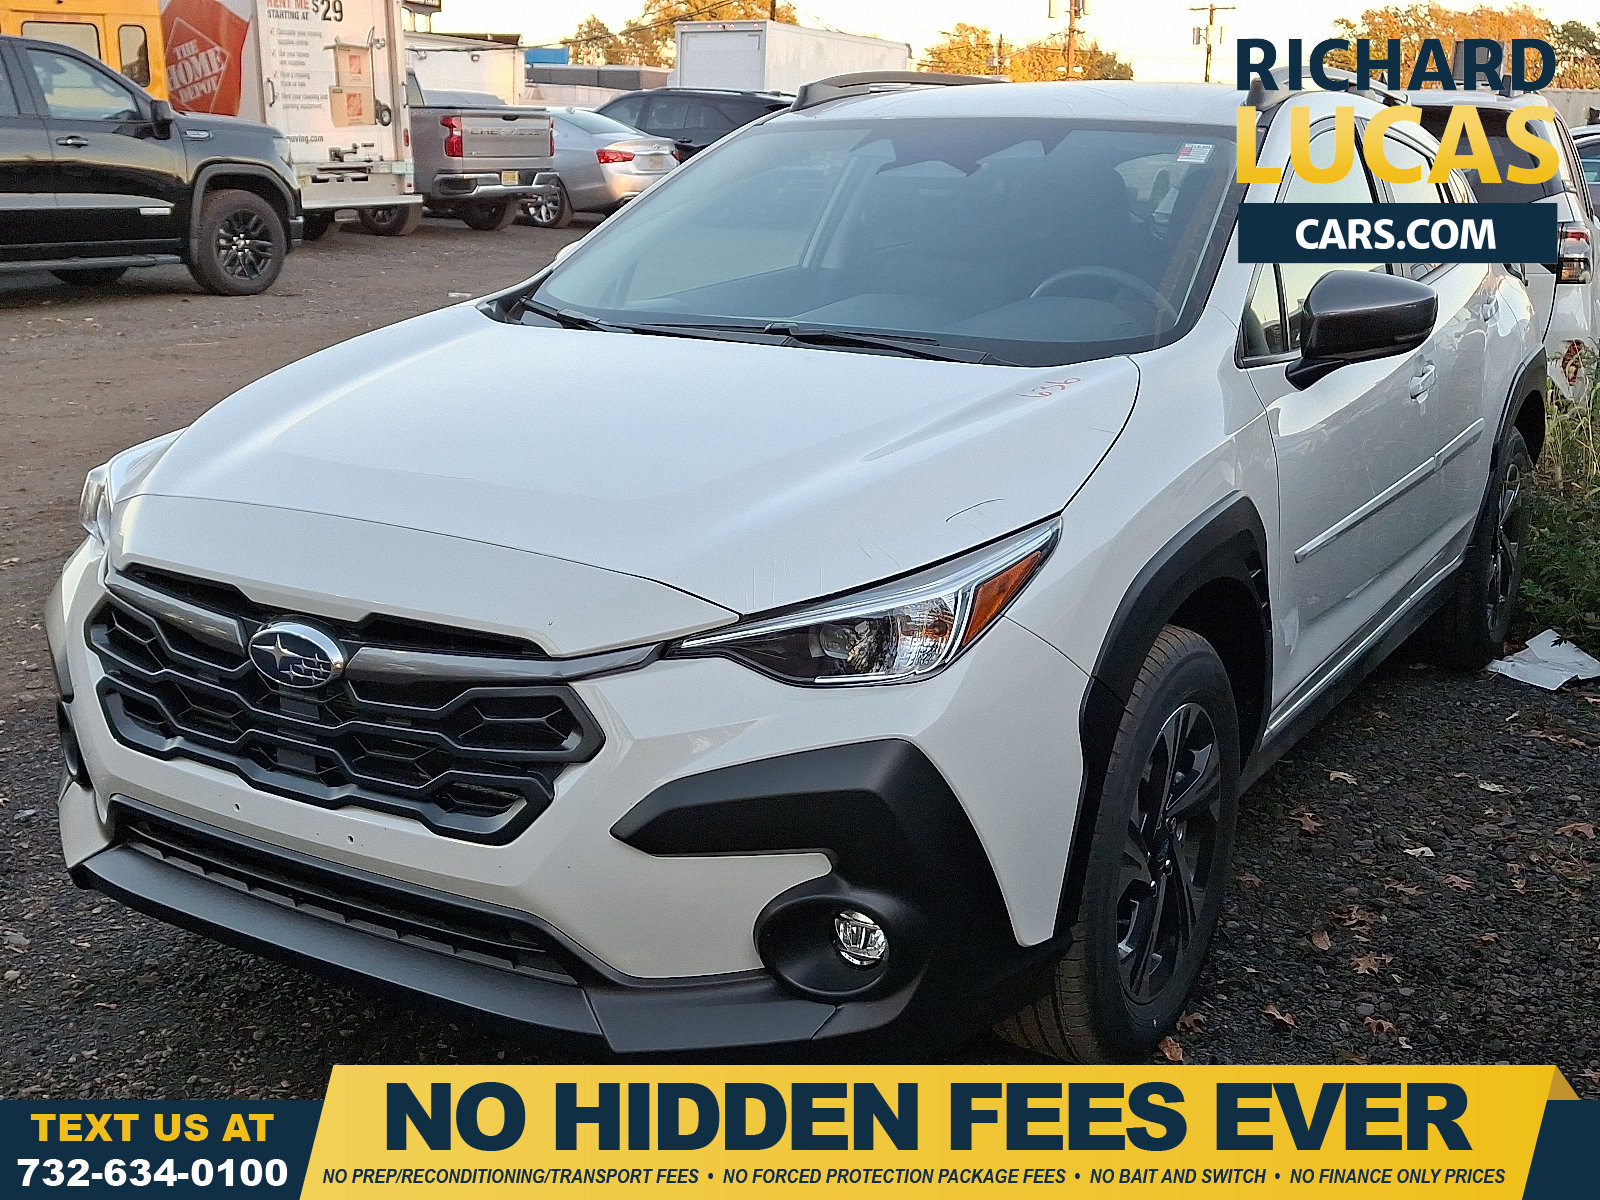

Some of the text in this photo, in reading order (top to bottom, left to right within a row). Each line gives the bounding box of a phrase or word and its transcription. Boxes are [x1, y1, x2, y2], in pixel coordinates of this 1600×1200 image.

[267, 9, 310, 20] STARTING AT
[312, 0, 343, 21] $29
[173, 39, 199, 60] THE
[179, 75, 218, 103] DEPOT
